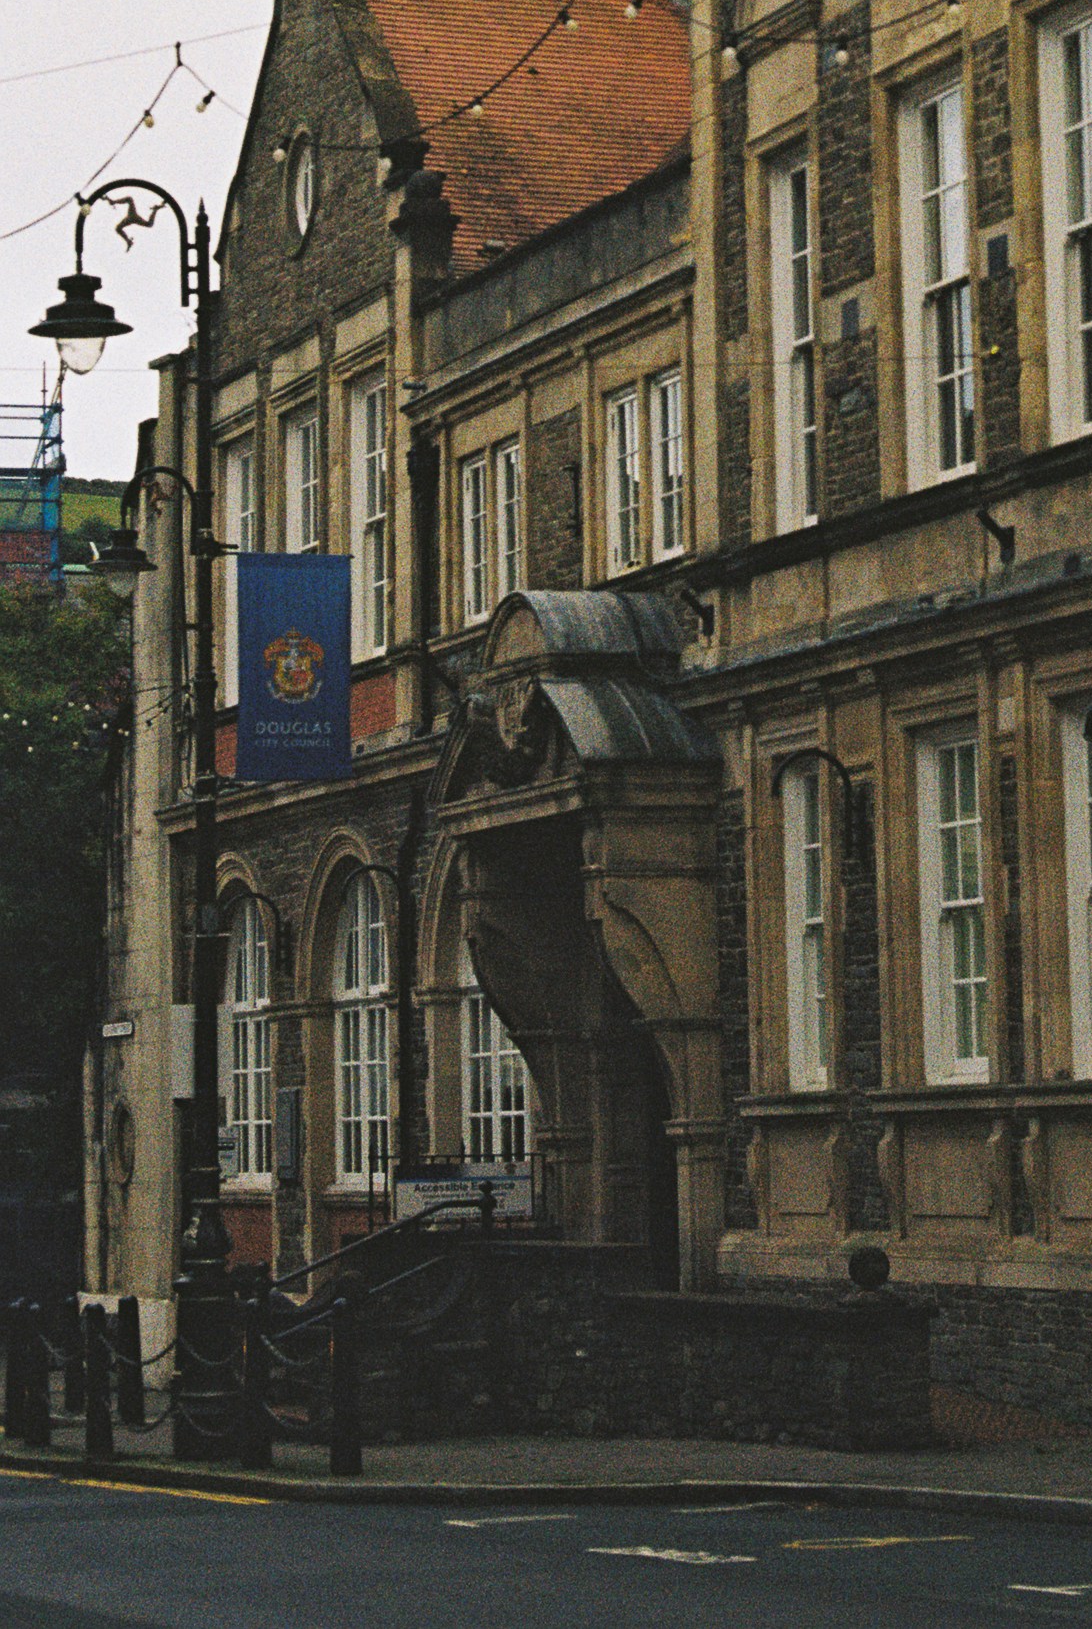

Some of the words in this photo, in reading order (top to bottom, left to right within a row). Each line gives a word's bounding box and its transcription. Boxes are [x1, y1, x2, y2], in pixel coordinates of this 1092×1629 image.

[255, 721, 331, 735] DOUGLAS
[254, 739, 279, 748] CITY
[282, 738, 330, 747] COUNCIL
[414, 1182, 469, 1192] Accessible
